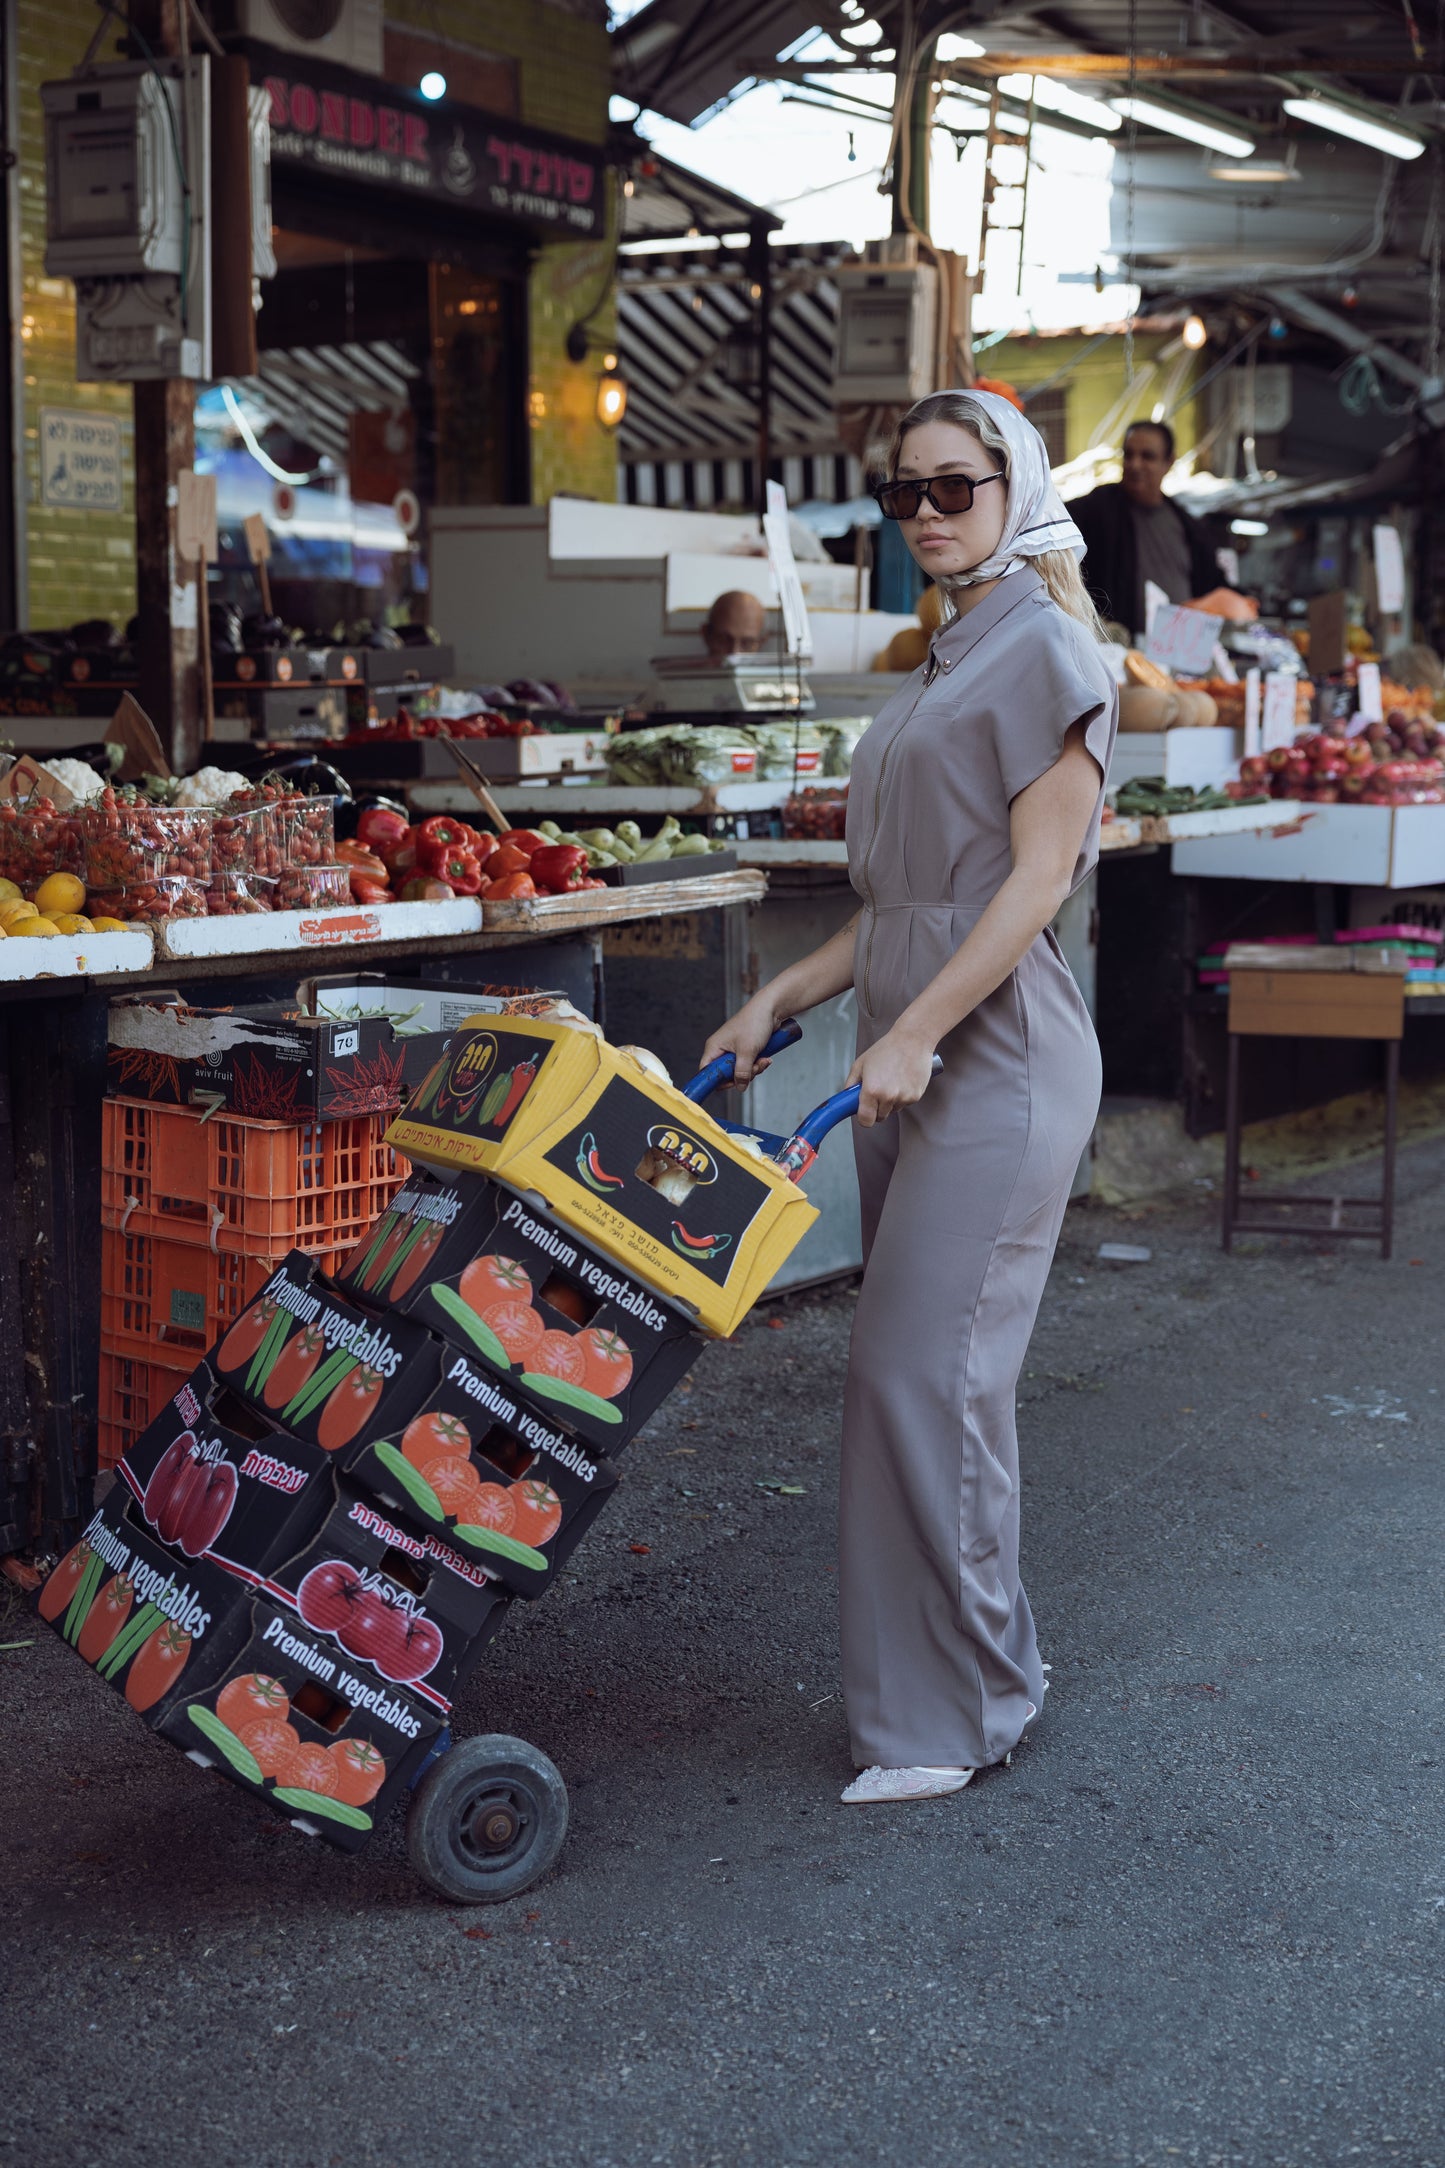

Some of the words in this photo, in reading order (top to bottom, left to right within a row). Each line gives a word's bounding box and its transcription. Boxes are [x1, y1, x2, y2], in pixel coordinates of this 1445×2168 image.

[264, 76, 429, 162] SONDER
[314, 141, 390, 177] Sandwich
[401, 162, 431, 187] Bar
[337, 1036, 353, 1050] 70
[456, 1042, 493, 1074] חזק
[195, 1068, 211, 1078] aviv
[214, 1070, 233, 1081] fruit
[657, 1131, 709, 1173] חזק
[412, 1187, 463, 1225] vegetables
[596, 1202, 625, 1229] פצאל
[629, 1229, 659, 1254] מושב
[502, 1200, 578, 1268] Premium
[579, 1259, 667, 1333] vegetables
[263, 1267, 322, 1325] Premium
[317, 1306, 402, 1378] vegetables
[447, 1357, 517, 1423] Premium
[517, 1413, 598, 1482] vegetables
[239, 1449, 309, 1494] עגבניות
[348, 1502, 425, 1559] מובחרות
[82, 1508, 131, 1574] Premium
[126, 1556, 211, 1639] vegetables
[423, 1534, 488, 1587] עגבניות
[262, 1617, 336, 1682] Premium
[336, 1670, 422, 1739] vegetables
